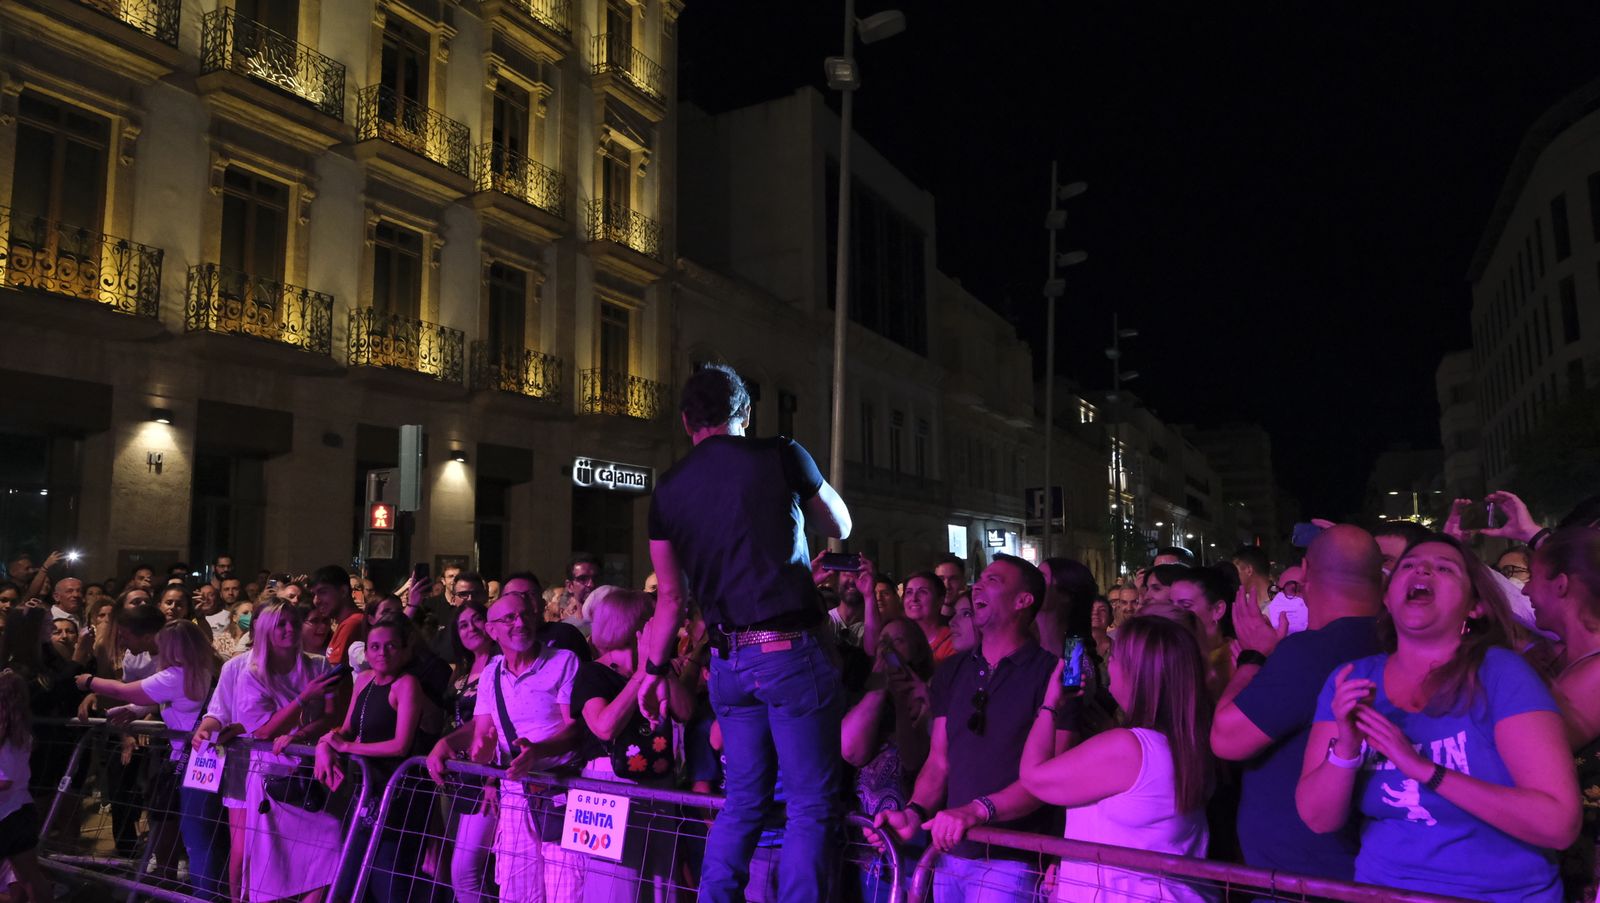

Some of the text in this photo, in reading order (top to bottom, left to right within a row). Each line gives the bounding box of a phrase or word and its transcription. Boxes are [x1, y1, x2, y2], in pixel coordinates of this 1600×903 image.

[598, 465, 649, 488] cajamar
[194, 757, 217, 769] RENTA
[191, 770, 214, 785] TODO
[577, 794, 616, 808] GRUPO
[574, 808, 613, 829] RENTA
[572, 827, 612, 851] TODO
